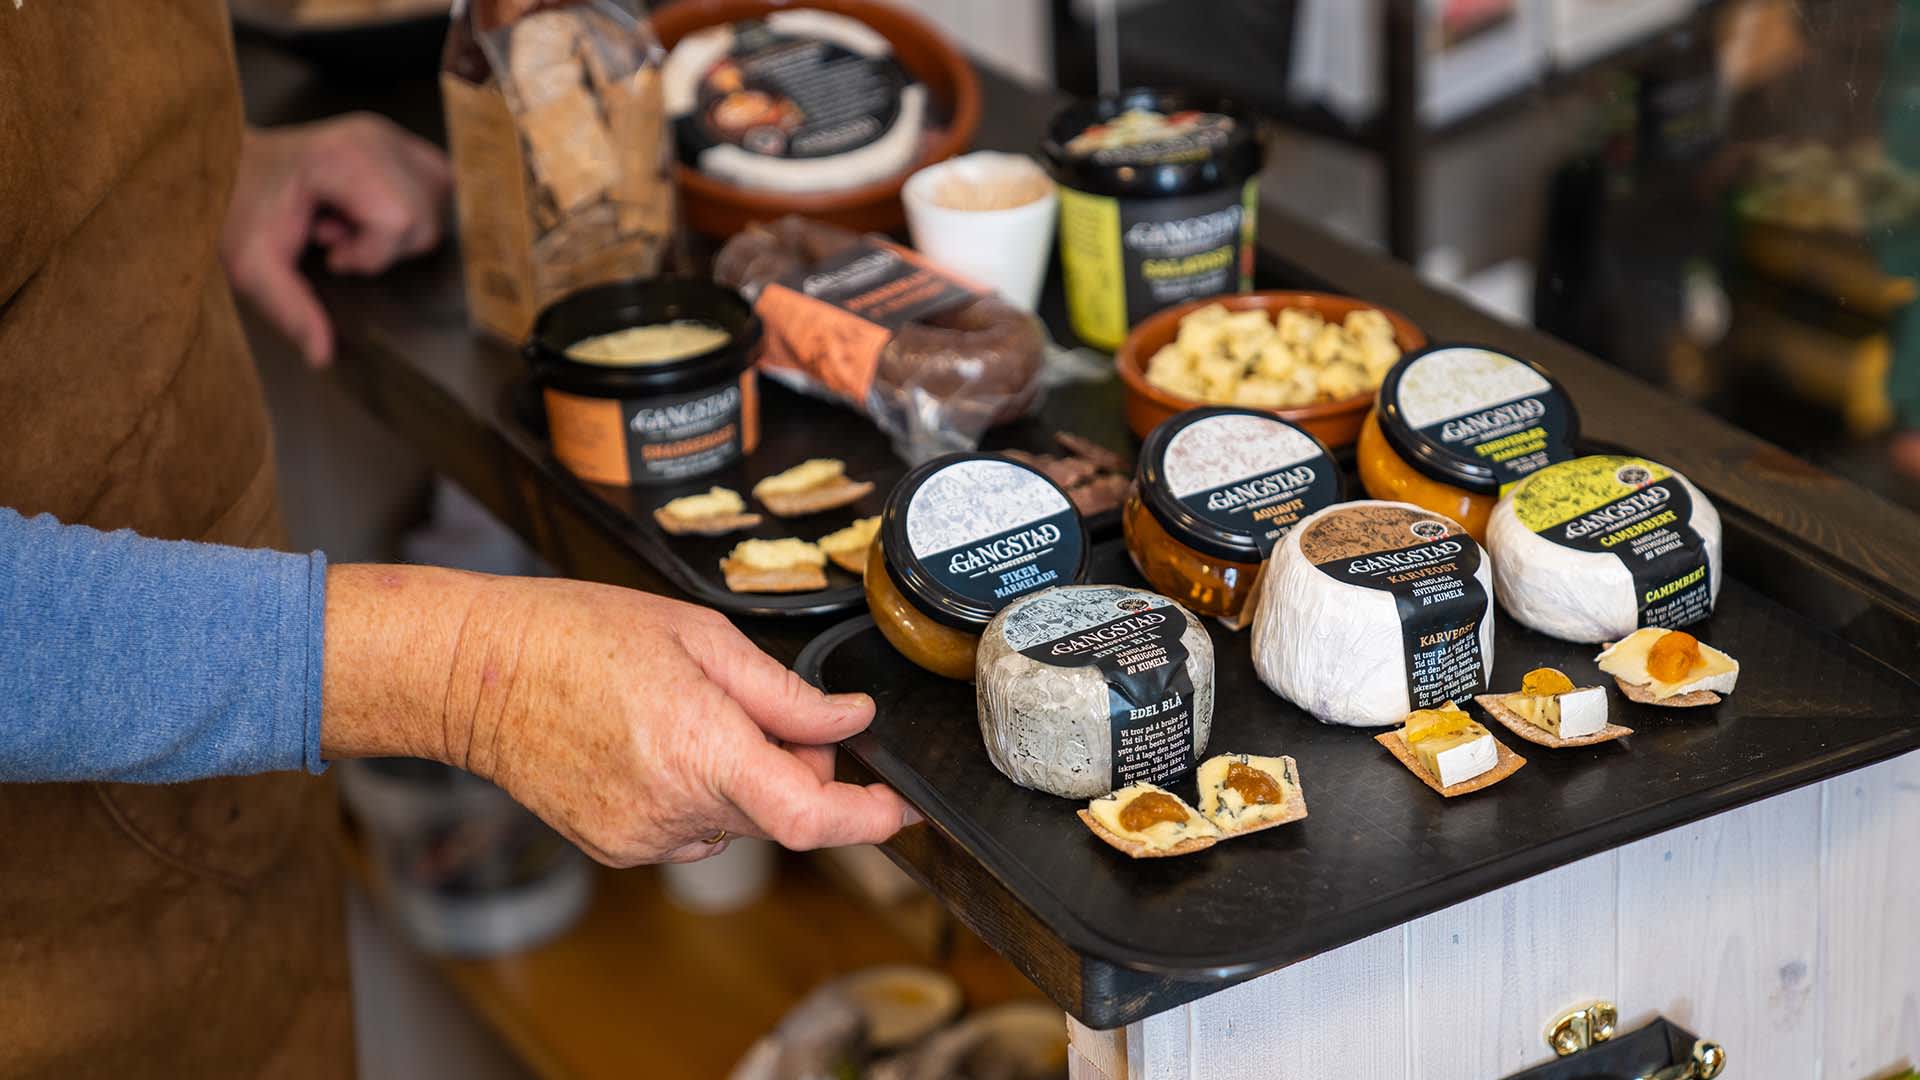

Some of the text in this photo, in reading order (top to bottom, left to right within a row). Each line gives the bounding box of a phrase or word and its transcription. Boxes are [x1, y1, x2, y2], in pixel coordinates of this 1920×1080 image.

[630, 387, 739, 432] GANGSTAD
[1442, 399, 1545, 442] GANGSTAD
[1208, 466, 1315, 510] GANGSTAD
[1252, 498, 1305, 521] AQUAVIT
[1566, 487, 1670, 539] GANGSTAD
[1601, 510, 1678, 548] CAMEMBERT
[949, 524, 1060, 574] GANGSTAD
[1349, 541, 1462, 574] GANGSTAD
[994, 570, 1058, 598] MARMELADE
[1000, 564, 1040, 585] FIKEN
[1387, 563, 1458, 584] KARVEOST
[1412, 575, 1453, 587] HANDLAGA
[1646, 565, 1705, 603] CAMEMBERT
[1413, 580, 1464, 597] HVITMUGGOST
[1423, 589, 1464, 606] AV KUMELK
[1052, 613, 1166, 655] GANGSTAD
[1420, 622, 1475, 647] KARVEOST
[1092, 643, 1131, 658] EDEL
[1117, 648, 1168, 666] BLÅMUGGOST
[1438, 648, 1446, 657] på
[1127, 656, 1169, 675] AV KUMELK
[1412, 669, 1425, 679] yste
[1454, 662, 1480, 677] lidenskap
[1450, 688, 1461, 697] god
[1462, 679, 1479, 691] smak.
[1130, 692, 1182, 720] EDEL BLÅ
[1131, 728, 1143, 736] tror
[1146, 724, 1153, 733] på
[1161, 717, 1178, 727] bruke
[1167, 725, 1176, 734] Tid
[1118, 727, 1190, 757] yste den beste osten og
[1142, 750, 1155, 759] lage
[1157, 746, 1168, 754] den
[1170, 739, 1185, 750] beste
[1118, 744, 1190, 772] iskremen. Vår lidenskap
[1151, 763, 1168, 772] måles
[1170, 756, 1181, 766] ikke
[1158, 771, 1168, 781] god
[1170, 763, 1187, 774] smak.
